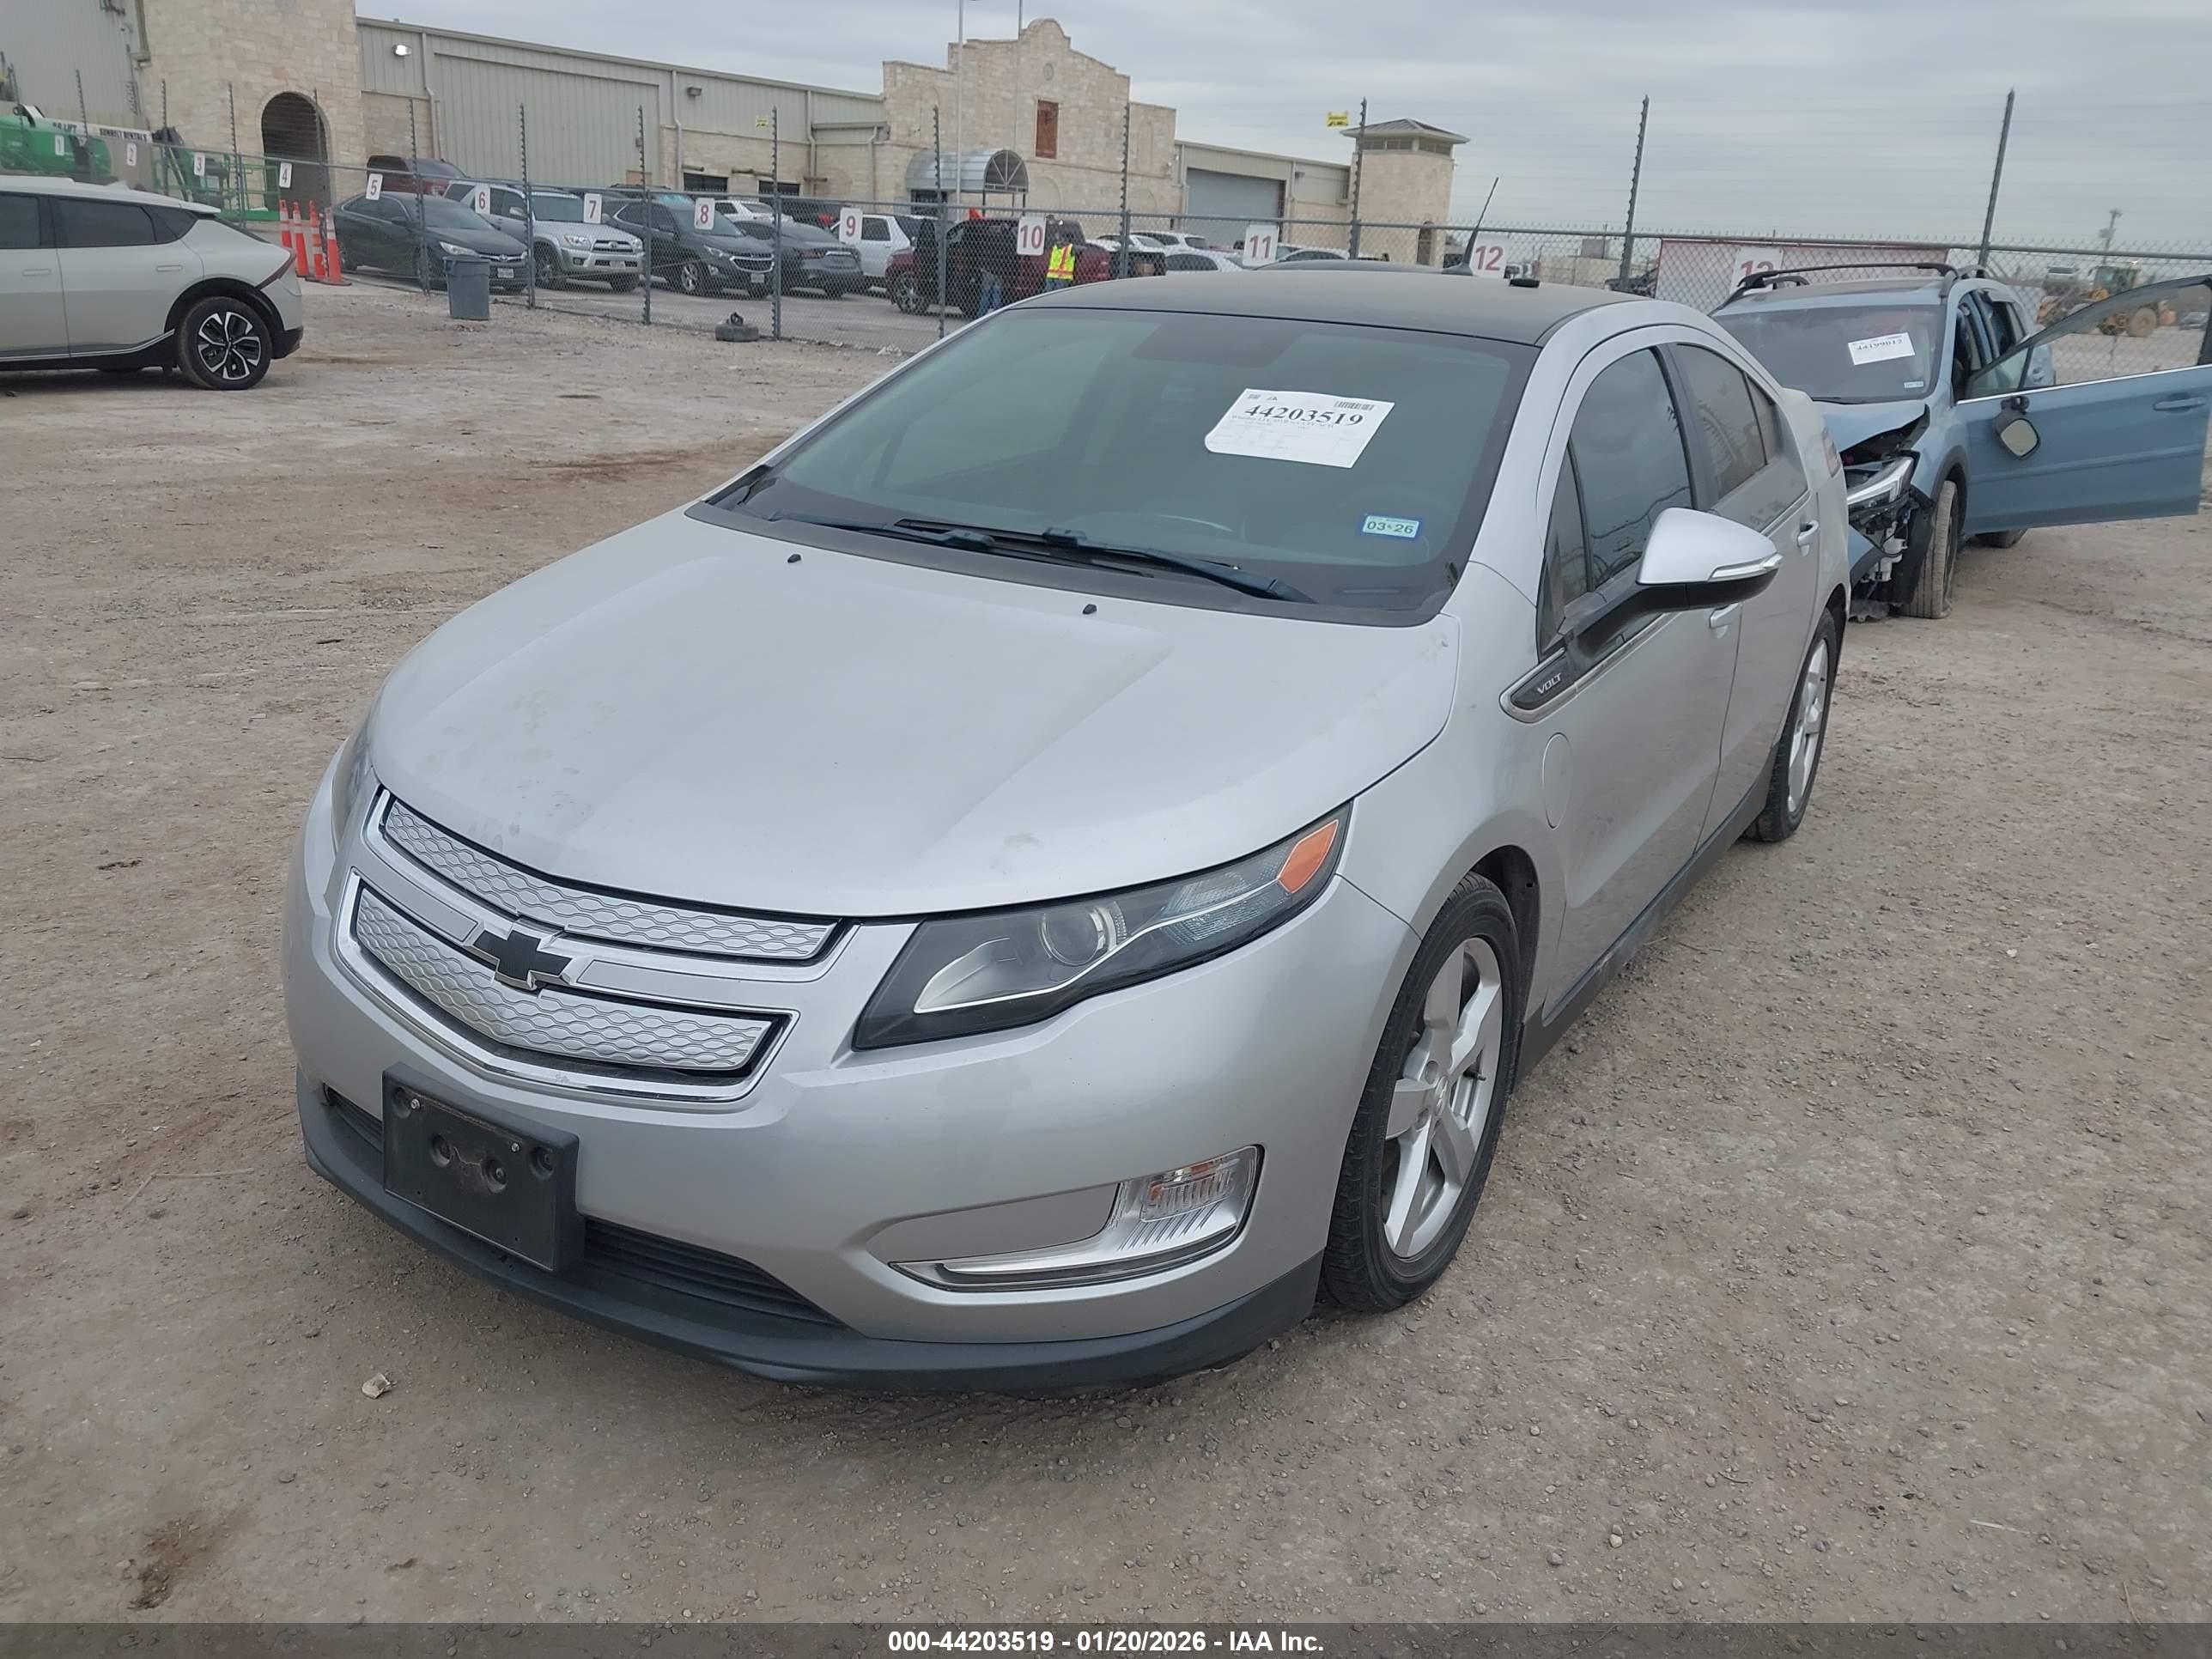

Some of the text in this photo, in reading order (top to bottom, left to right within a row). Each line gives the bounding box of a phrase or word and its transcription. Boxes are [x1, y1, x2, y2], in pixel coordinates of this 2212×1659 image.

[197, 156, 203, 173] 3
[282, 167, 288, 184] 4
[369, 179, 378, 196] 5
[478, 191, 486, 210] 6
[589, 200, 597, 218] 7
[700, 204, 709, 224] 8
[846, 216, 855, 238] 9
[1020, 225, 1043, 249] 10
[1249, 235, 1272, 258] 11
[1475, 246, 1504, 270] 12
[1244, 404, 1364, 426] 44203519
[1537, 673, 1562, 694] VOLT
